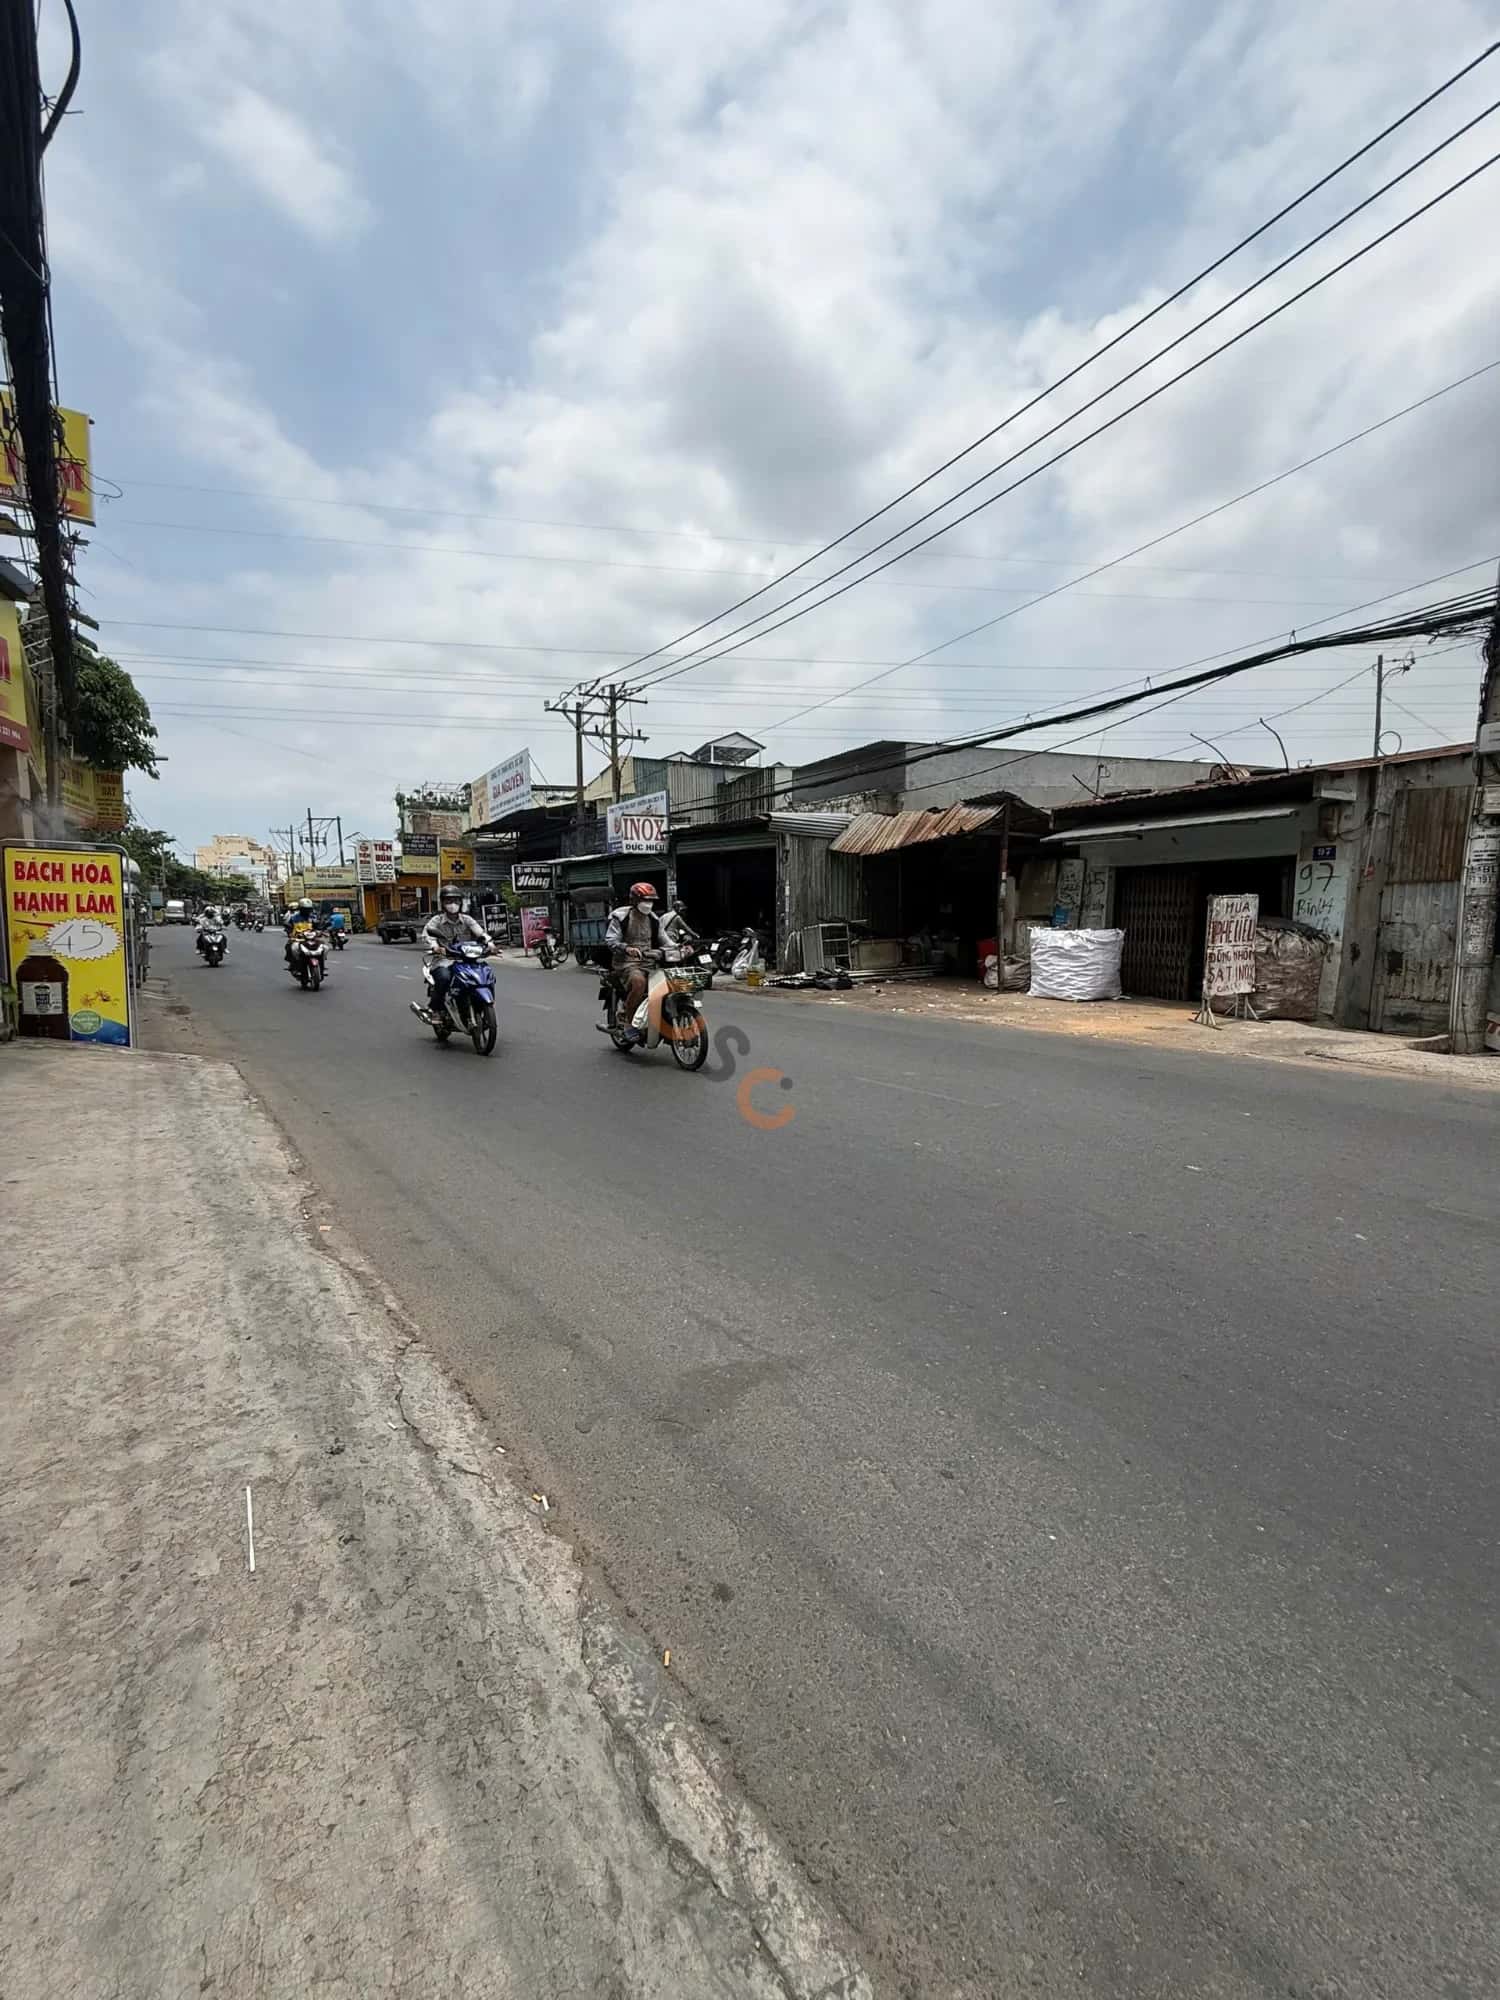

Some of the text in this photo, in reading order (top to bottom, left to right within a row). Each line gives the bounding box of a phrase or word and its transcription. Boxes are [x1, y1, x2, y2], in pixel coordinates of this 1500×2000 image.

[622, 818, 666, 841] INOX
[14, 857, 64, 881] BÁCH
[1298, 862, 1342, 895] 97
[13, 890, 116, 918] HẠNH LÂM
[50, 923, 104, 953] 45
